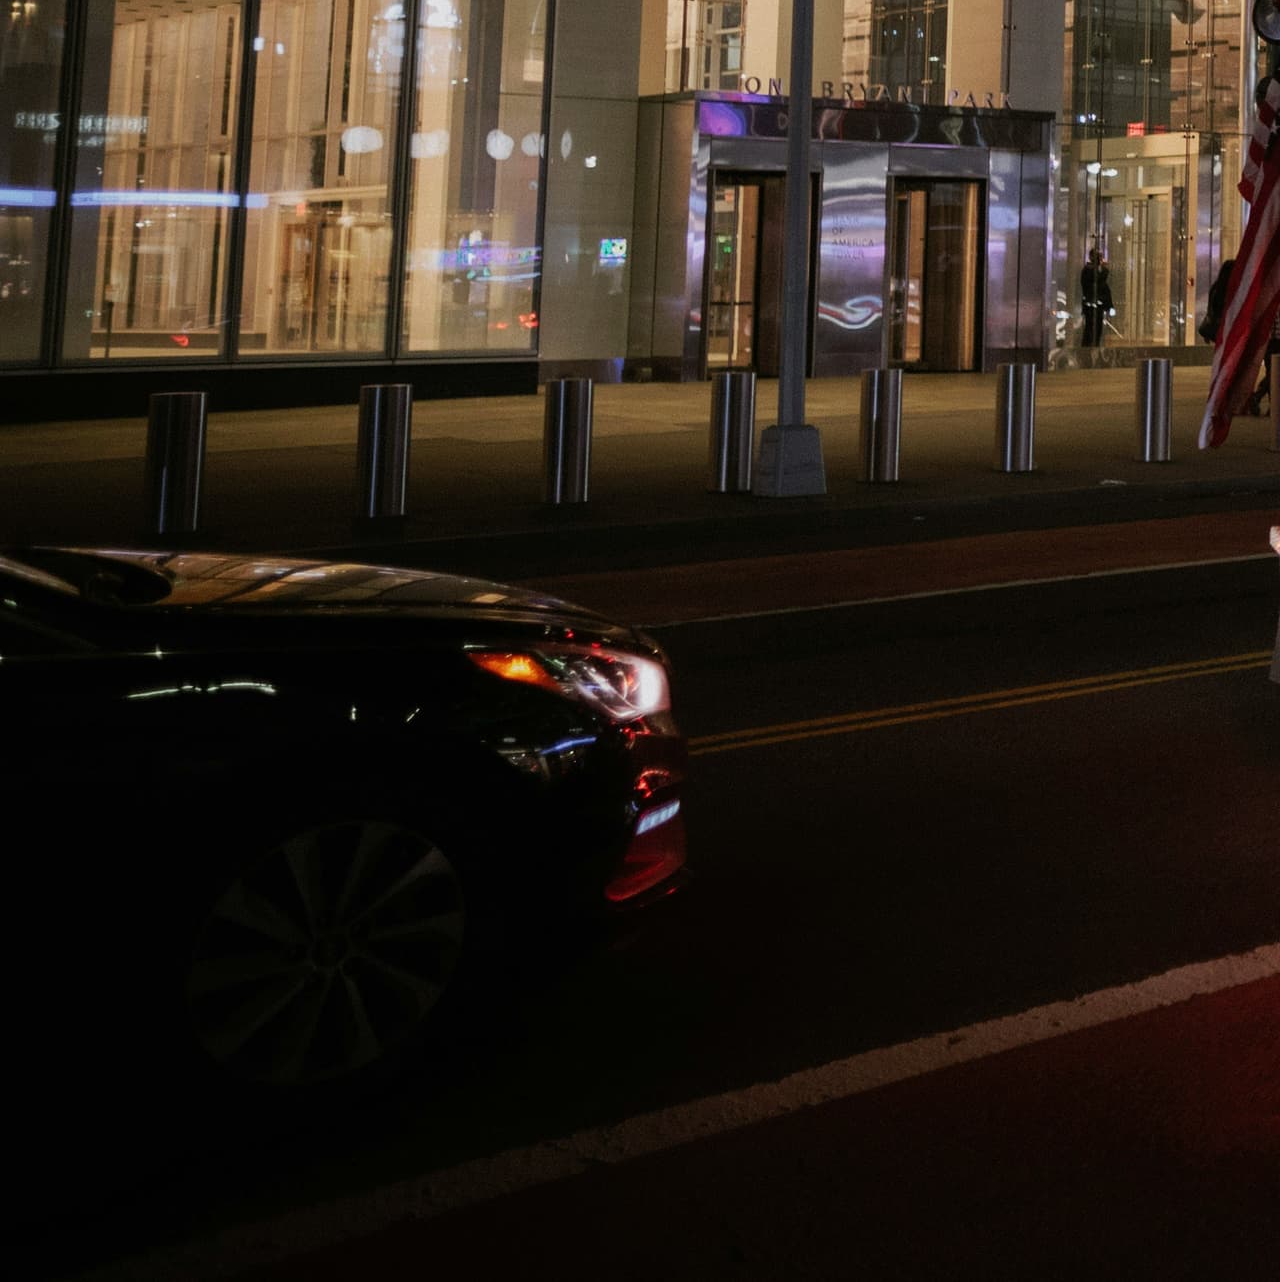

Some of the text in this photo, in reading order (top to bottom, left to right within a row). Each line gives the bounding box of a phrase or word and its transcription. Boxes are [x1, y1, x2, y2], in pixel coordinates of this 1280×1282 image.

[744, 76, 1014, 110] ON BRYANT PARK
